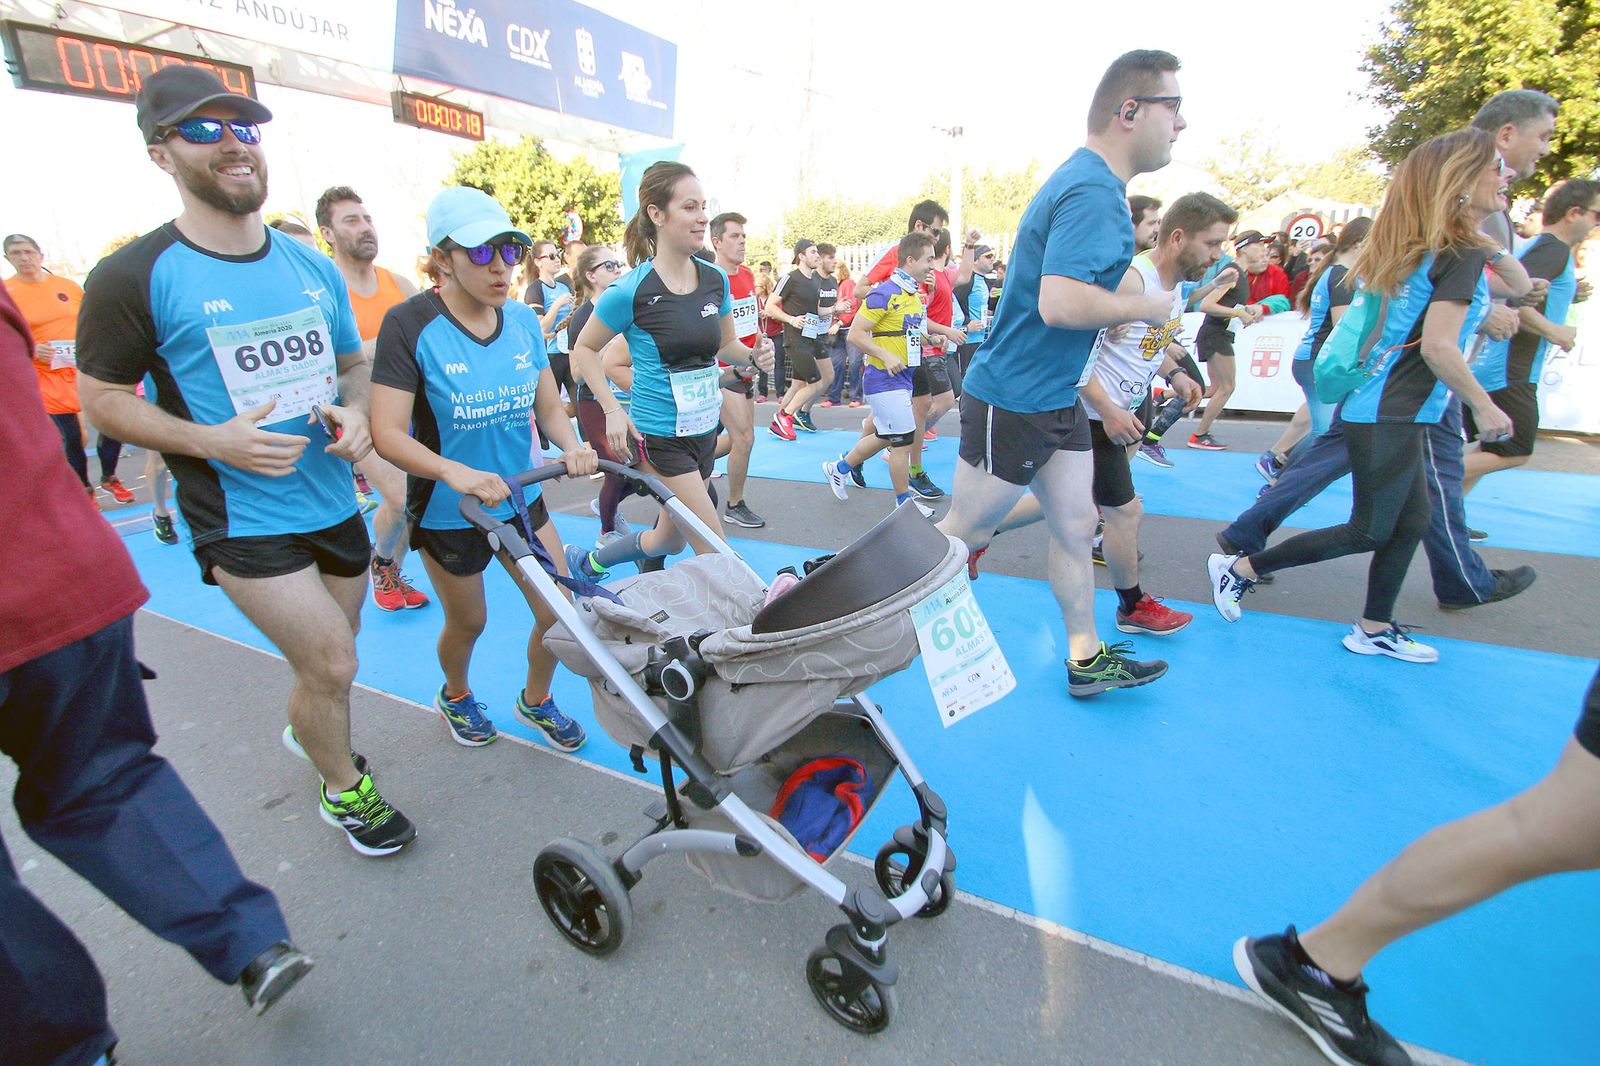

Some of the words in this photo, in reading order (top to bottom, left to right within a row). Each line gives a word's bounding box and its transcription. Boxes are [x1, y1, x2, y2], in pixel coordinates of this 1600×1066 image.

[236, 0, 349, 41] ANDÚJAR
[424, 0, 488, 48] NEXA
[506, 23, 551, 62] CDX
[1294, 226, 1316, 237] 20
[732, 304, 756, 319] 5579
[277, 325, 293, 333] 2020
[235, 330, 325, 373] 6098
[255, 365, 290, 381] ALMA'S
[291, 359, 320, 375] DADDY
[451, 390, 495, 405] Medio
[682, 380, 719, 402] 541
[453, 401, 511, 420] Almería
[453, 421, 488, 431] RAMÓN
[490, 414, 507, 425] RUIZ
